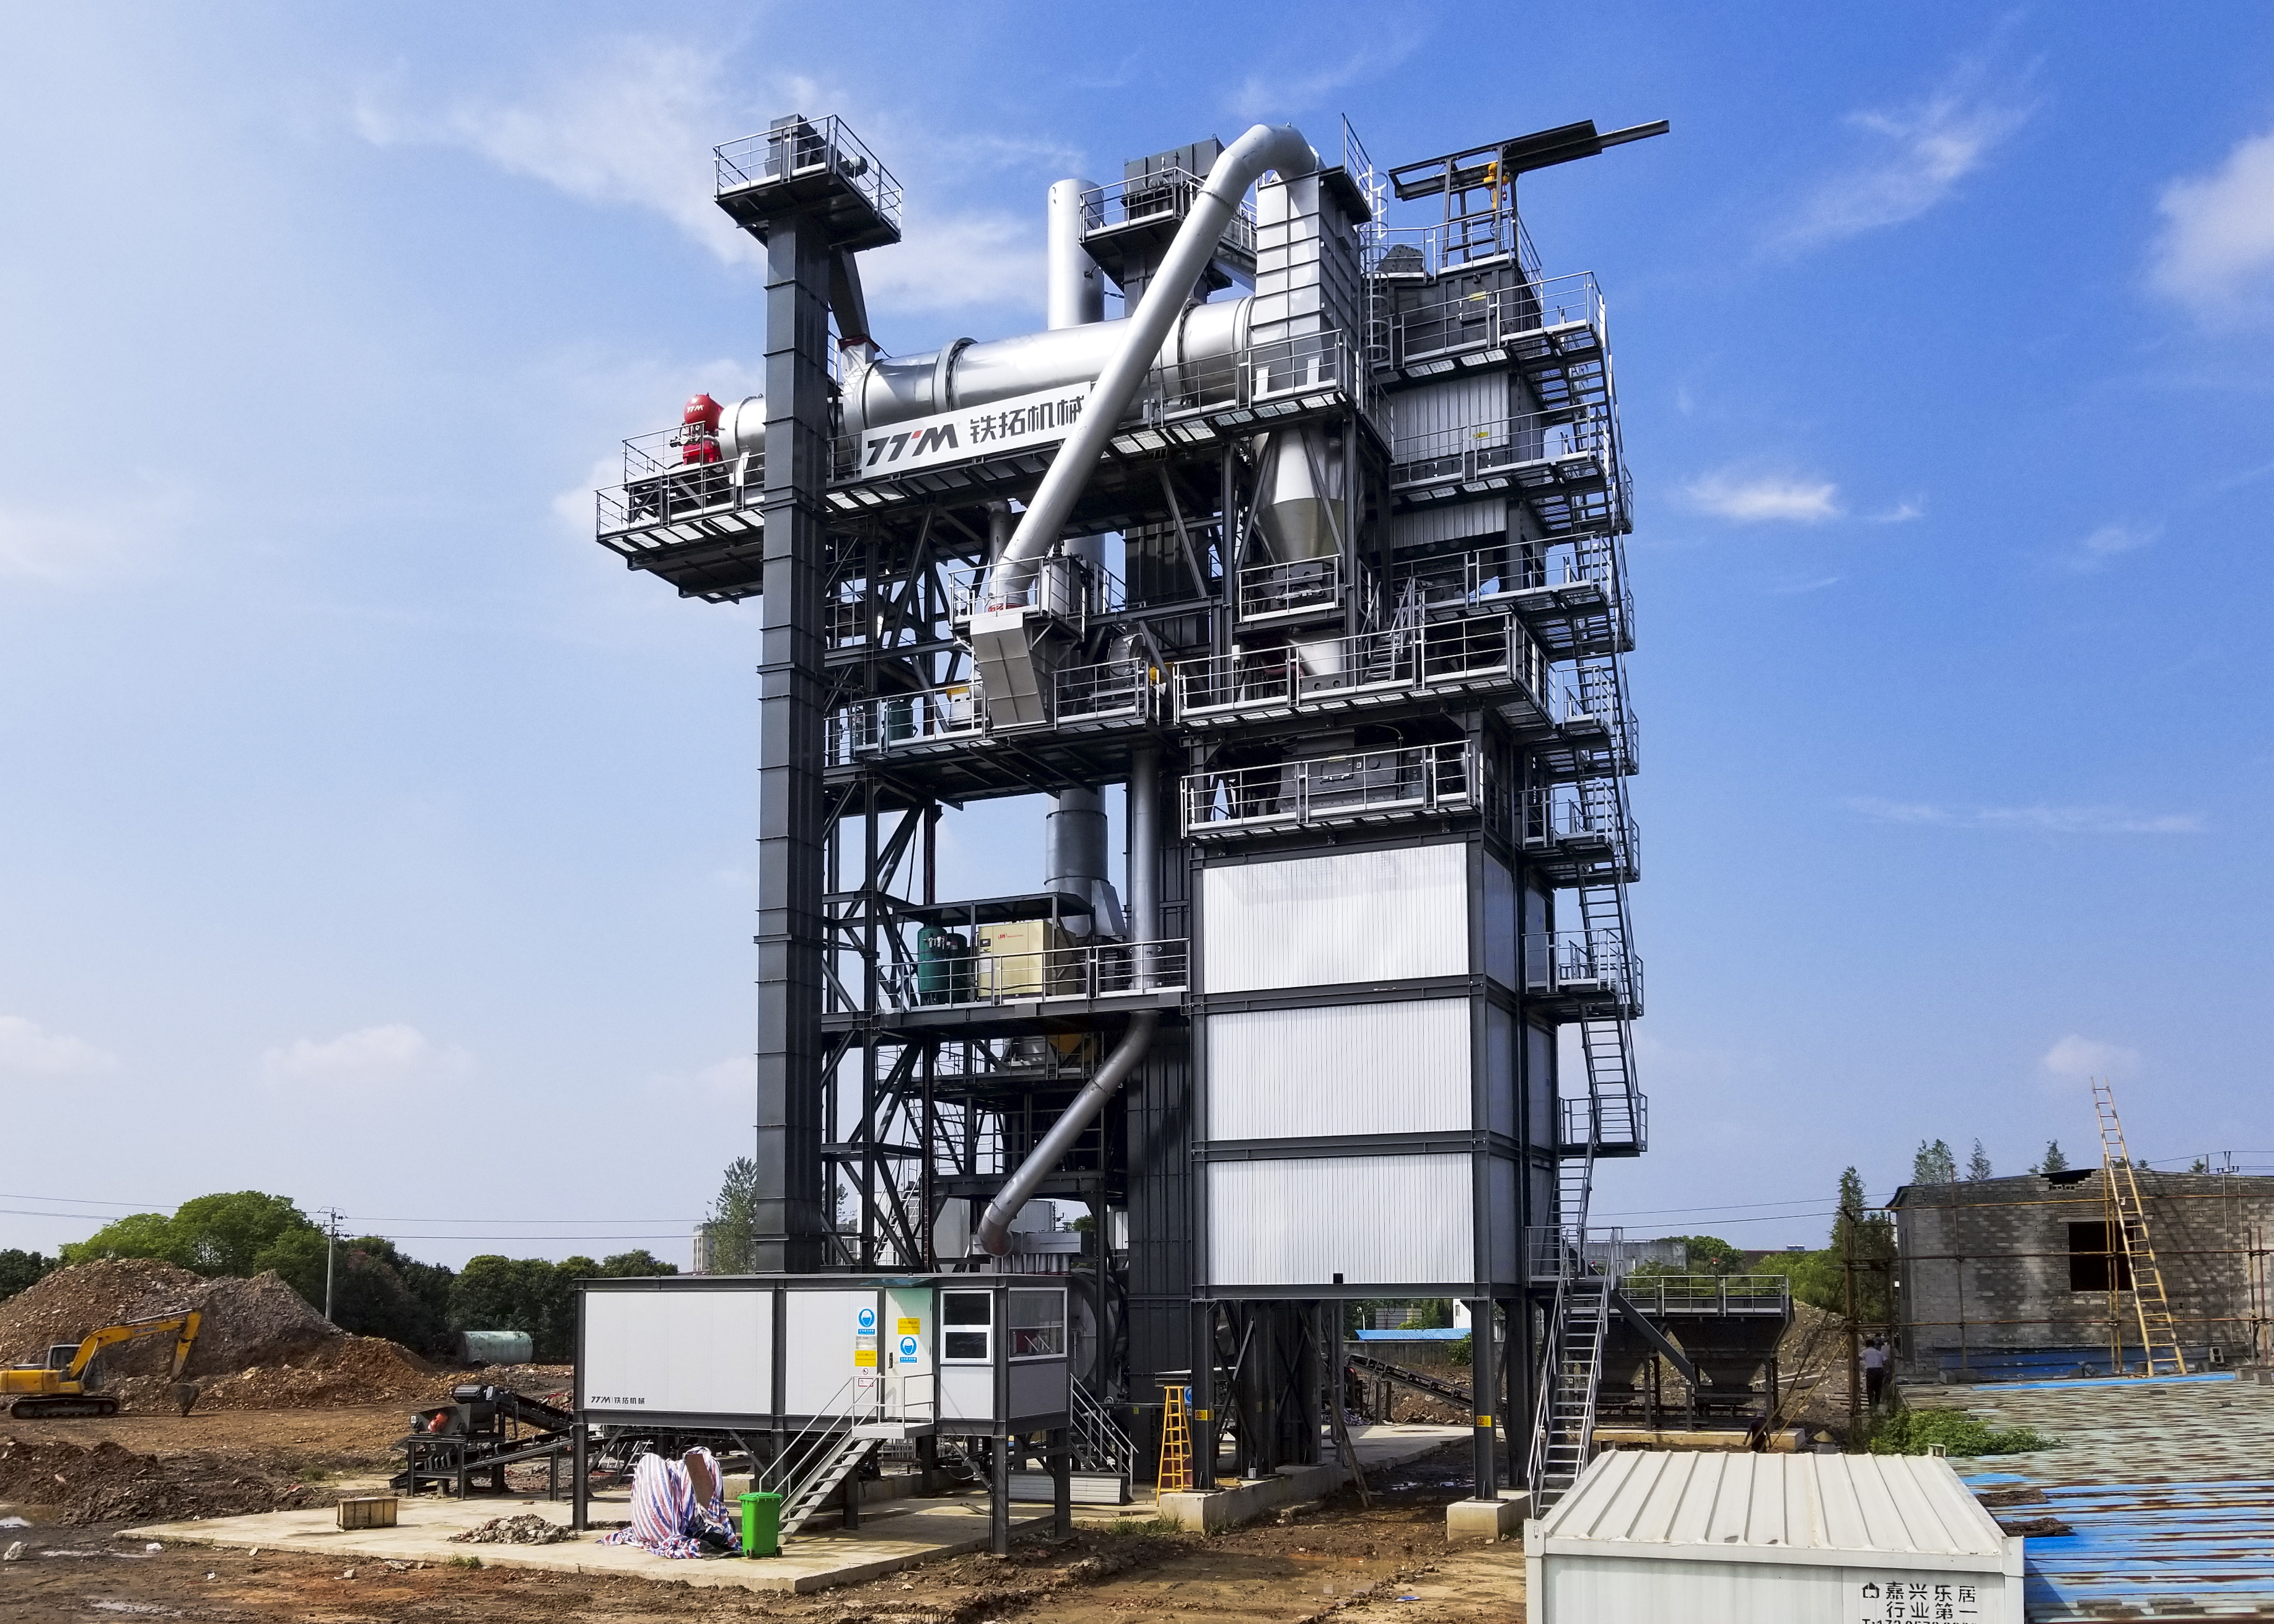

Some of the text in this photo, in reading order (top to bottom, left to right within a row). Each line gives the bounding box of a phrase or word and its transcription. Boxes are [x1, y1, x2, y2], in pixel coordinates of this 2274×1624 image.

[970, 395, 1085, 444] 铁拓机械
[614, 1397, 646, 1405] 铁拓机械
[1885, 1581, 1977, 1603] 嘉兴乐居
[1886, 1601, 1978, 1620] 行业第一
